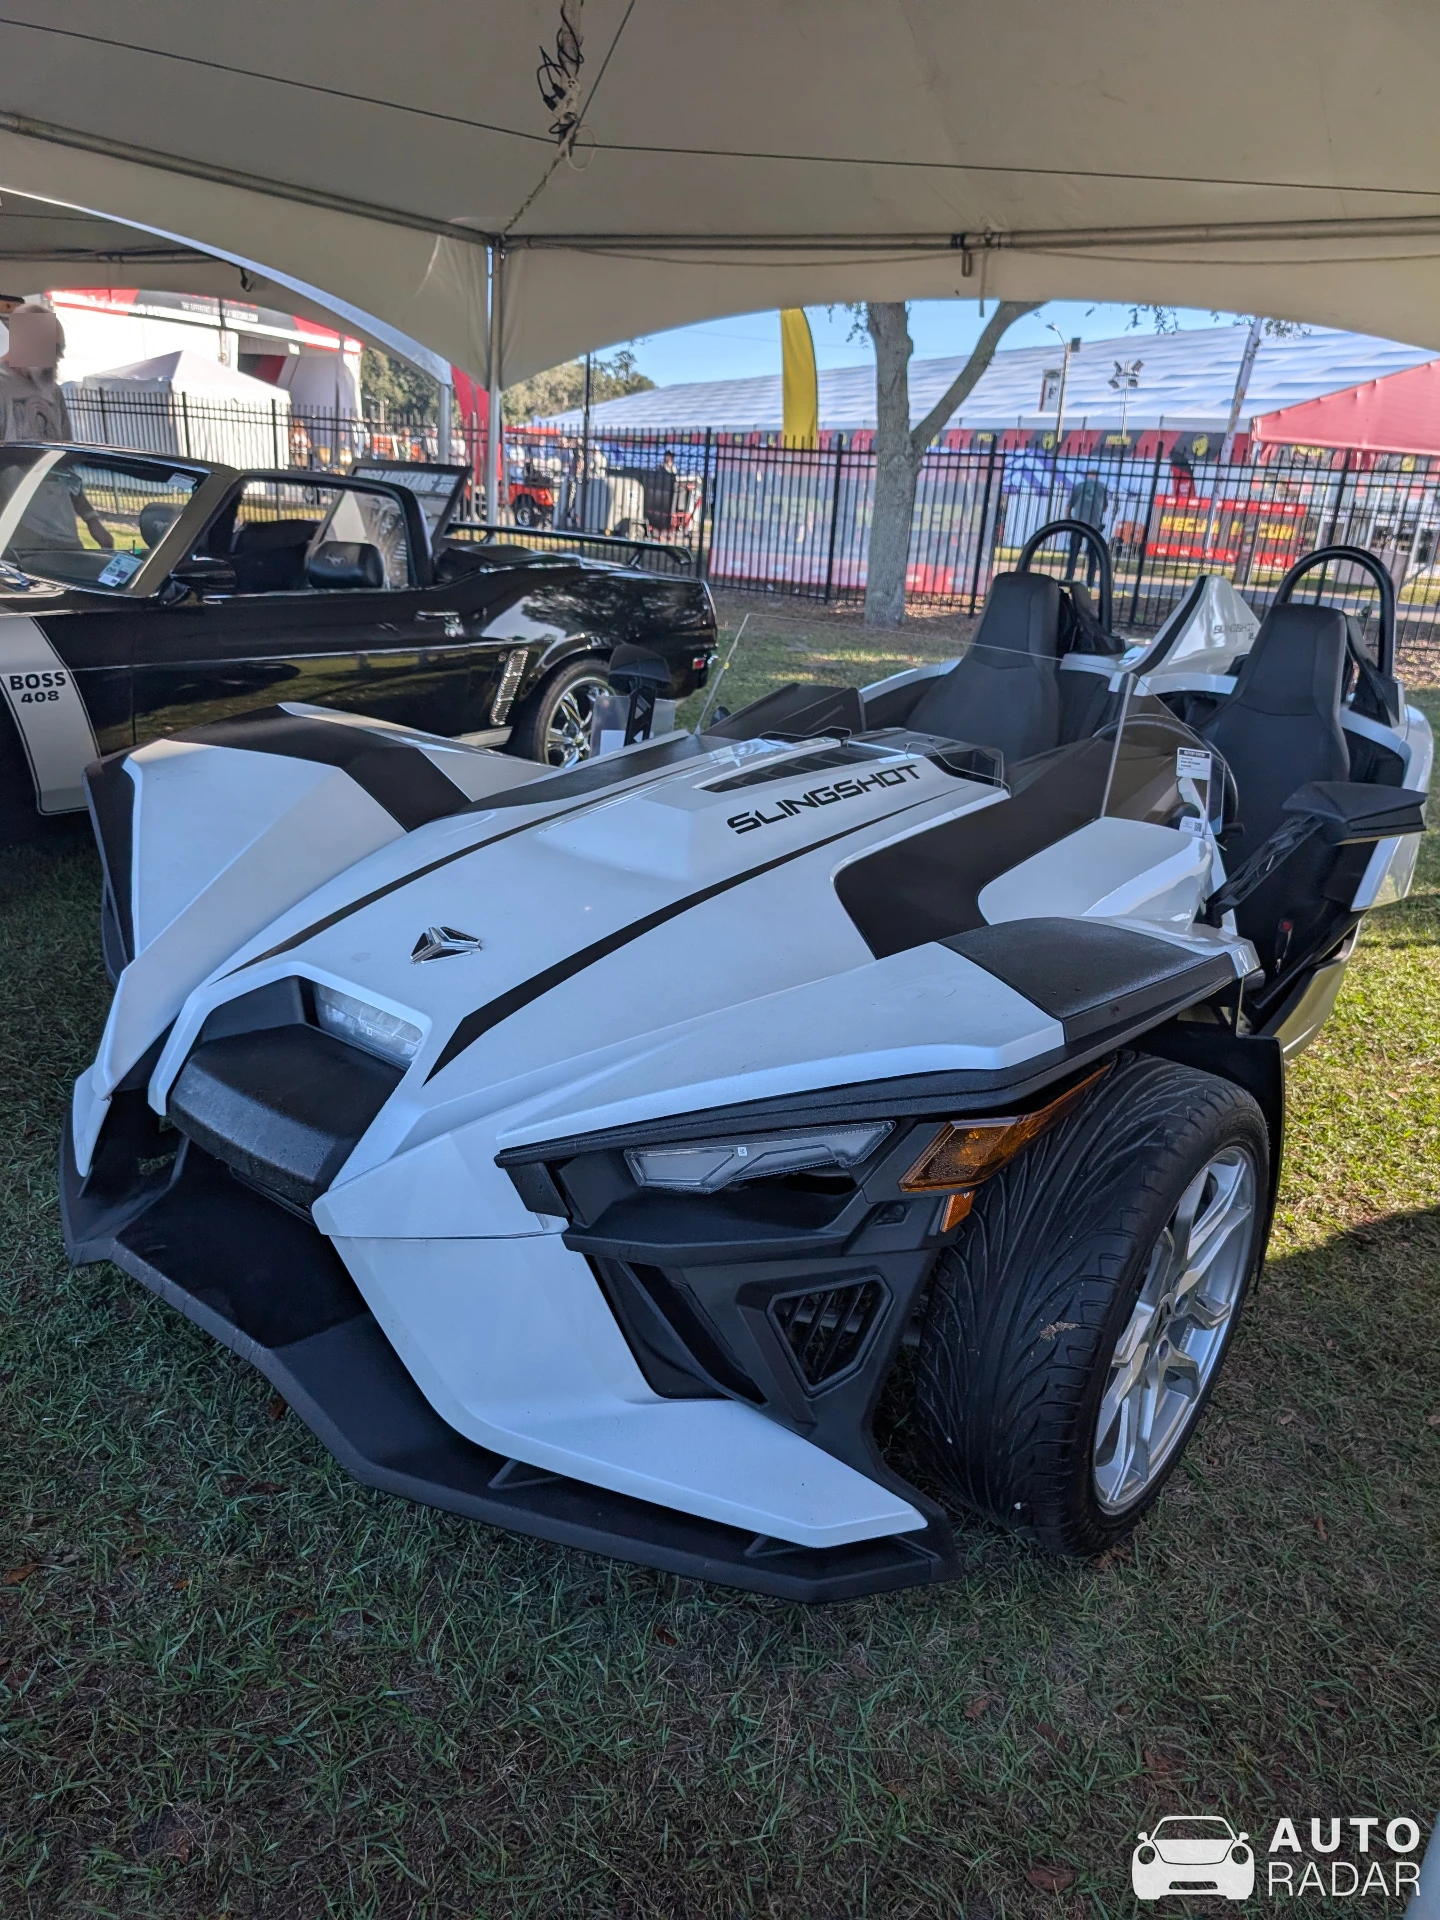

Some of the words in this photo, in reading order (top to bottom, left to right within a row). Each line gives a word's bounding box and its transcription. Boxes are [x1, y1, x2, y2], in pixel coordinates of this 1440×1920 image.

[1160, 516, 1220, 535] MECUM
[9, 671, 67, 691] BOSS
[20, 690, 60, 704] 408
[726, 764, 921, 835] SLINGSHOT
